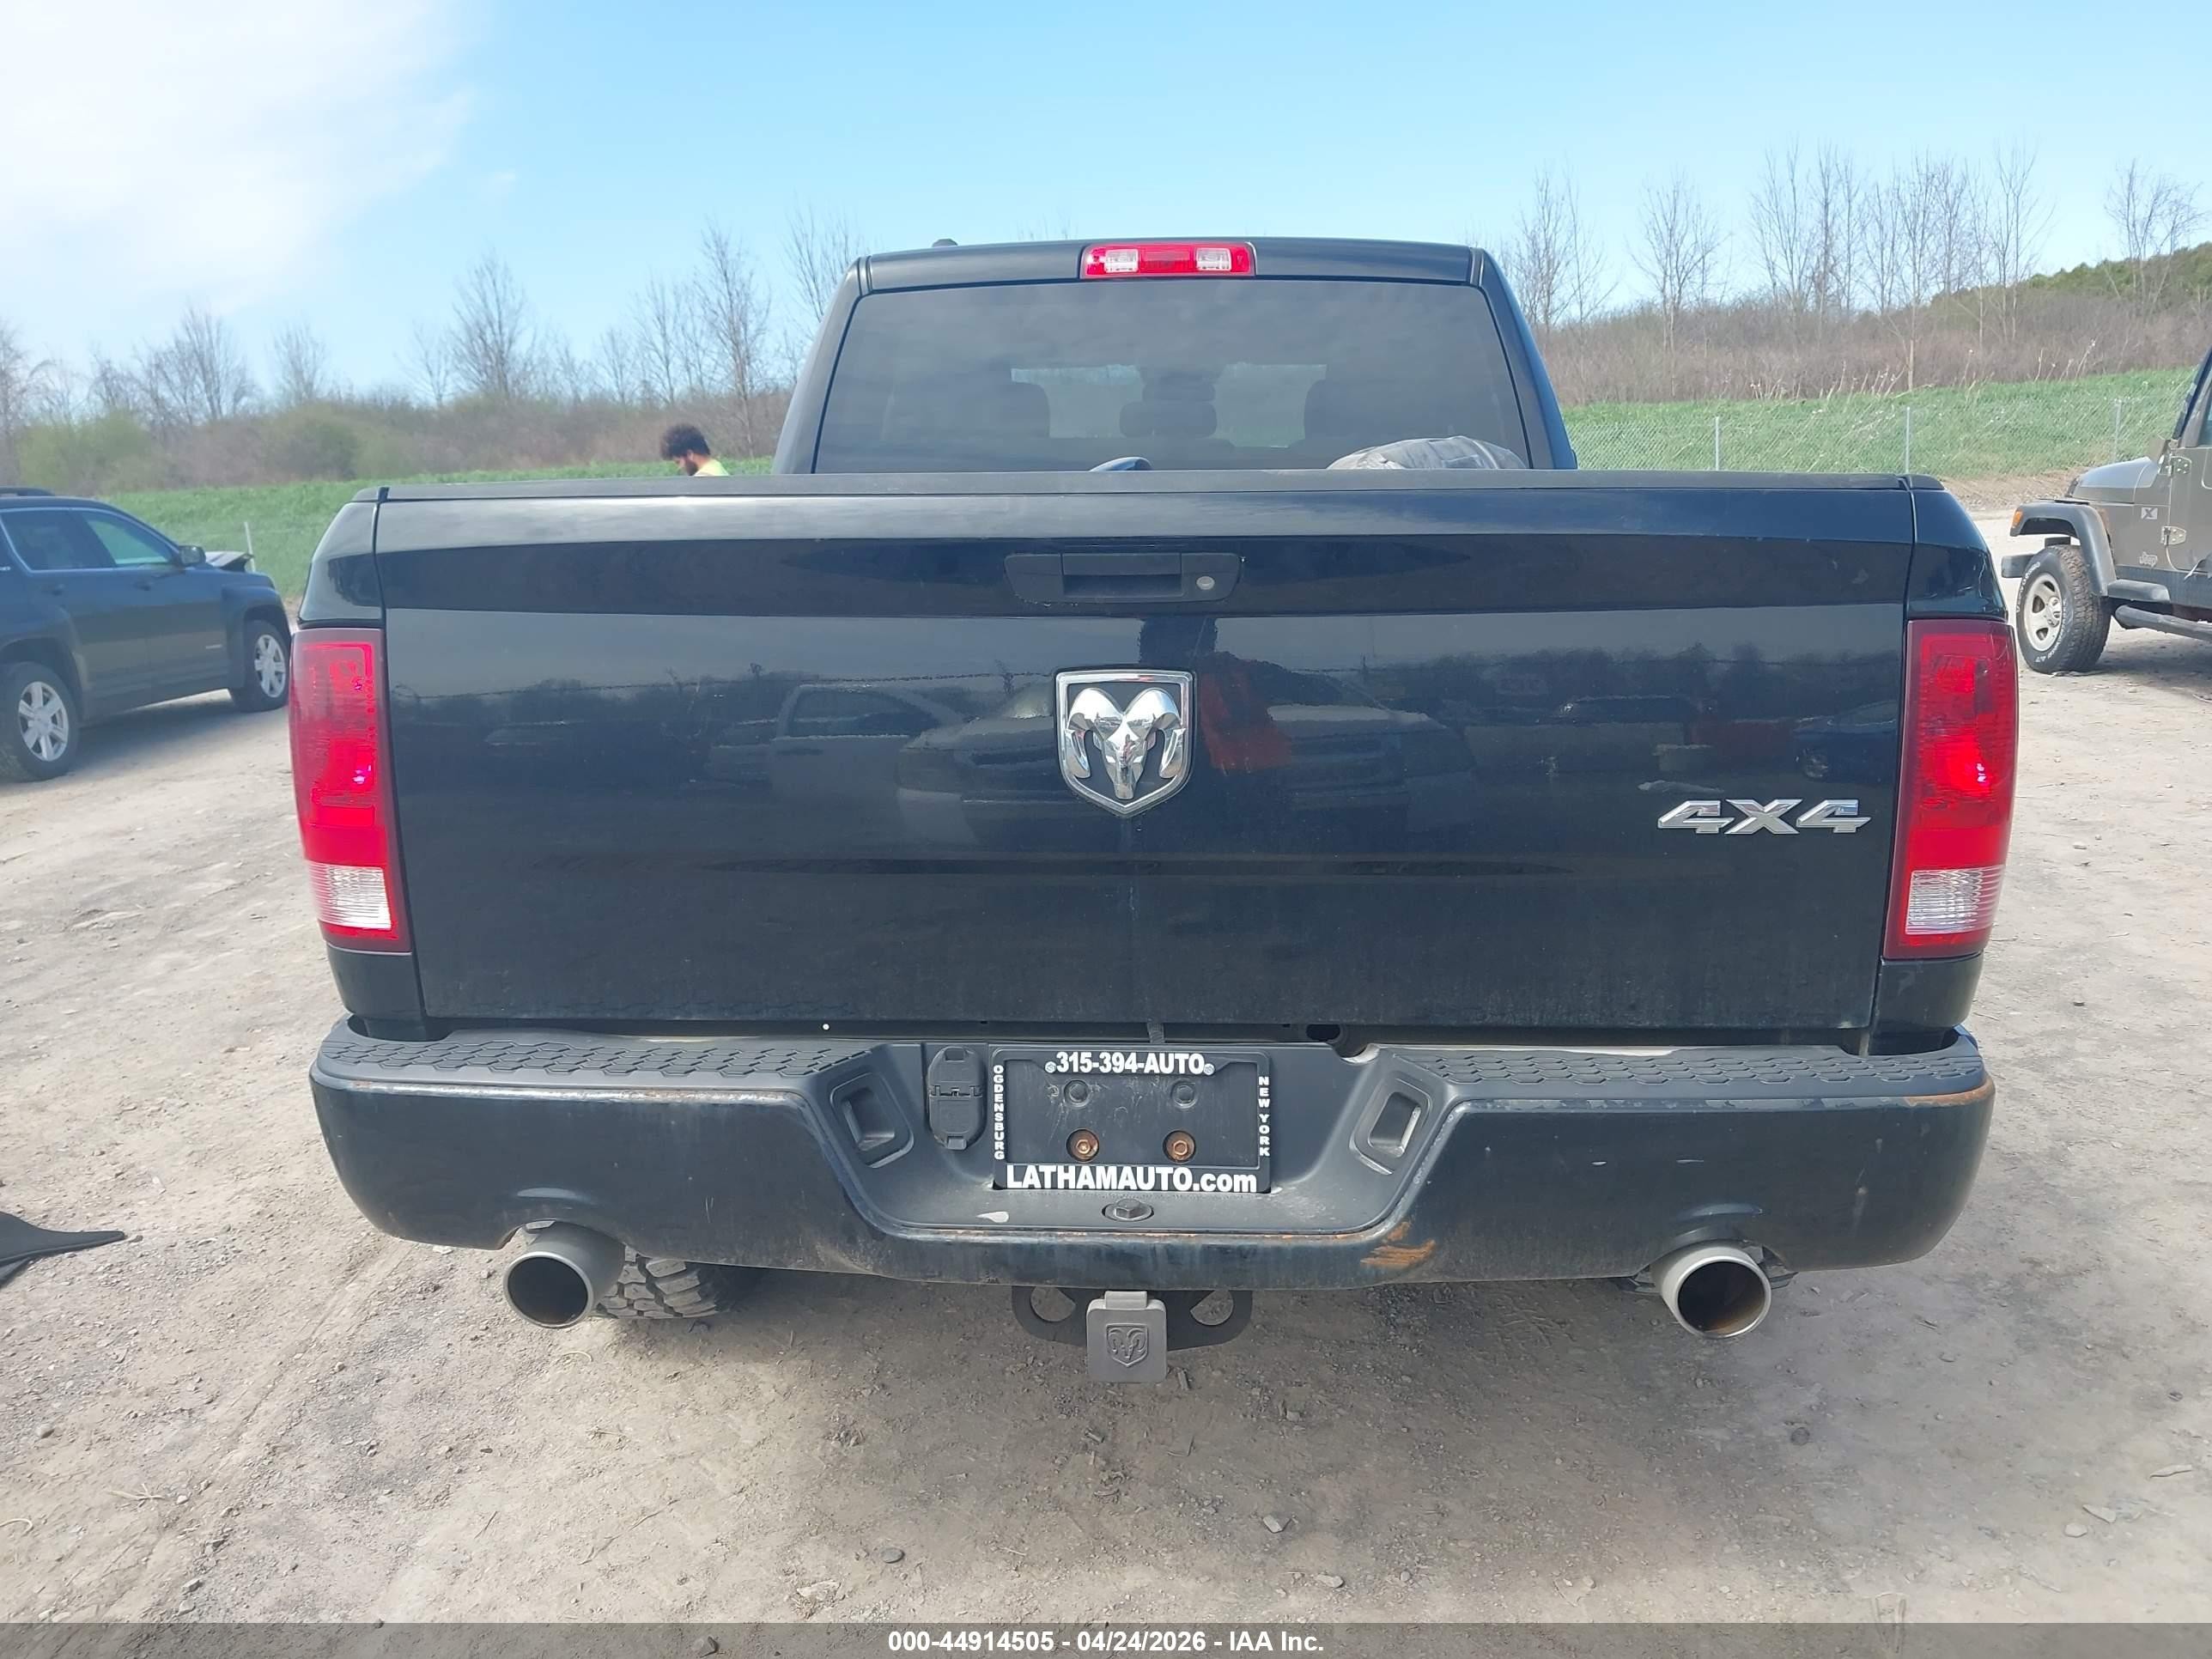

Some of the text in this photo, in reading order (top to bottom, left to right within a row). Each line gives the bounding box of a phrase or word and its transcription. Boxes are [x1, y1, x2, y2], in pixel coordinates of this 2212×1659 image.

[1657, 799, 1871, 835] 4X4
[1056, 1051, 1205, 1075] 315-394-AUTO
[993, 1065, 1005, 1160] OGDENSBURG
[1258, 1076, 1270, 1157] NEW YORK
[1006, 1164, 1257, 1193] LATHAMAUTO.com
